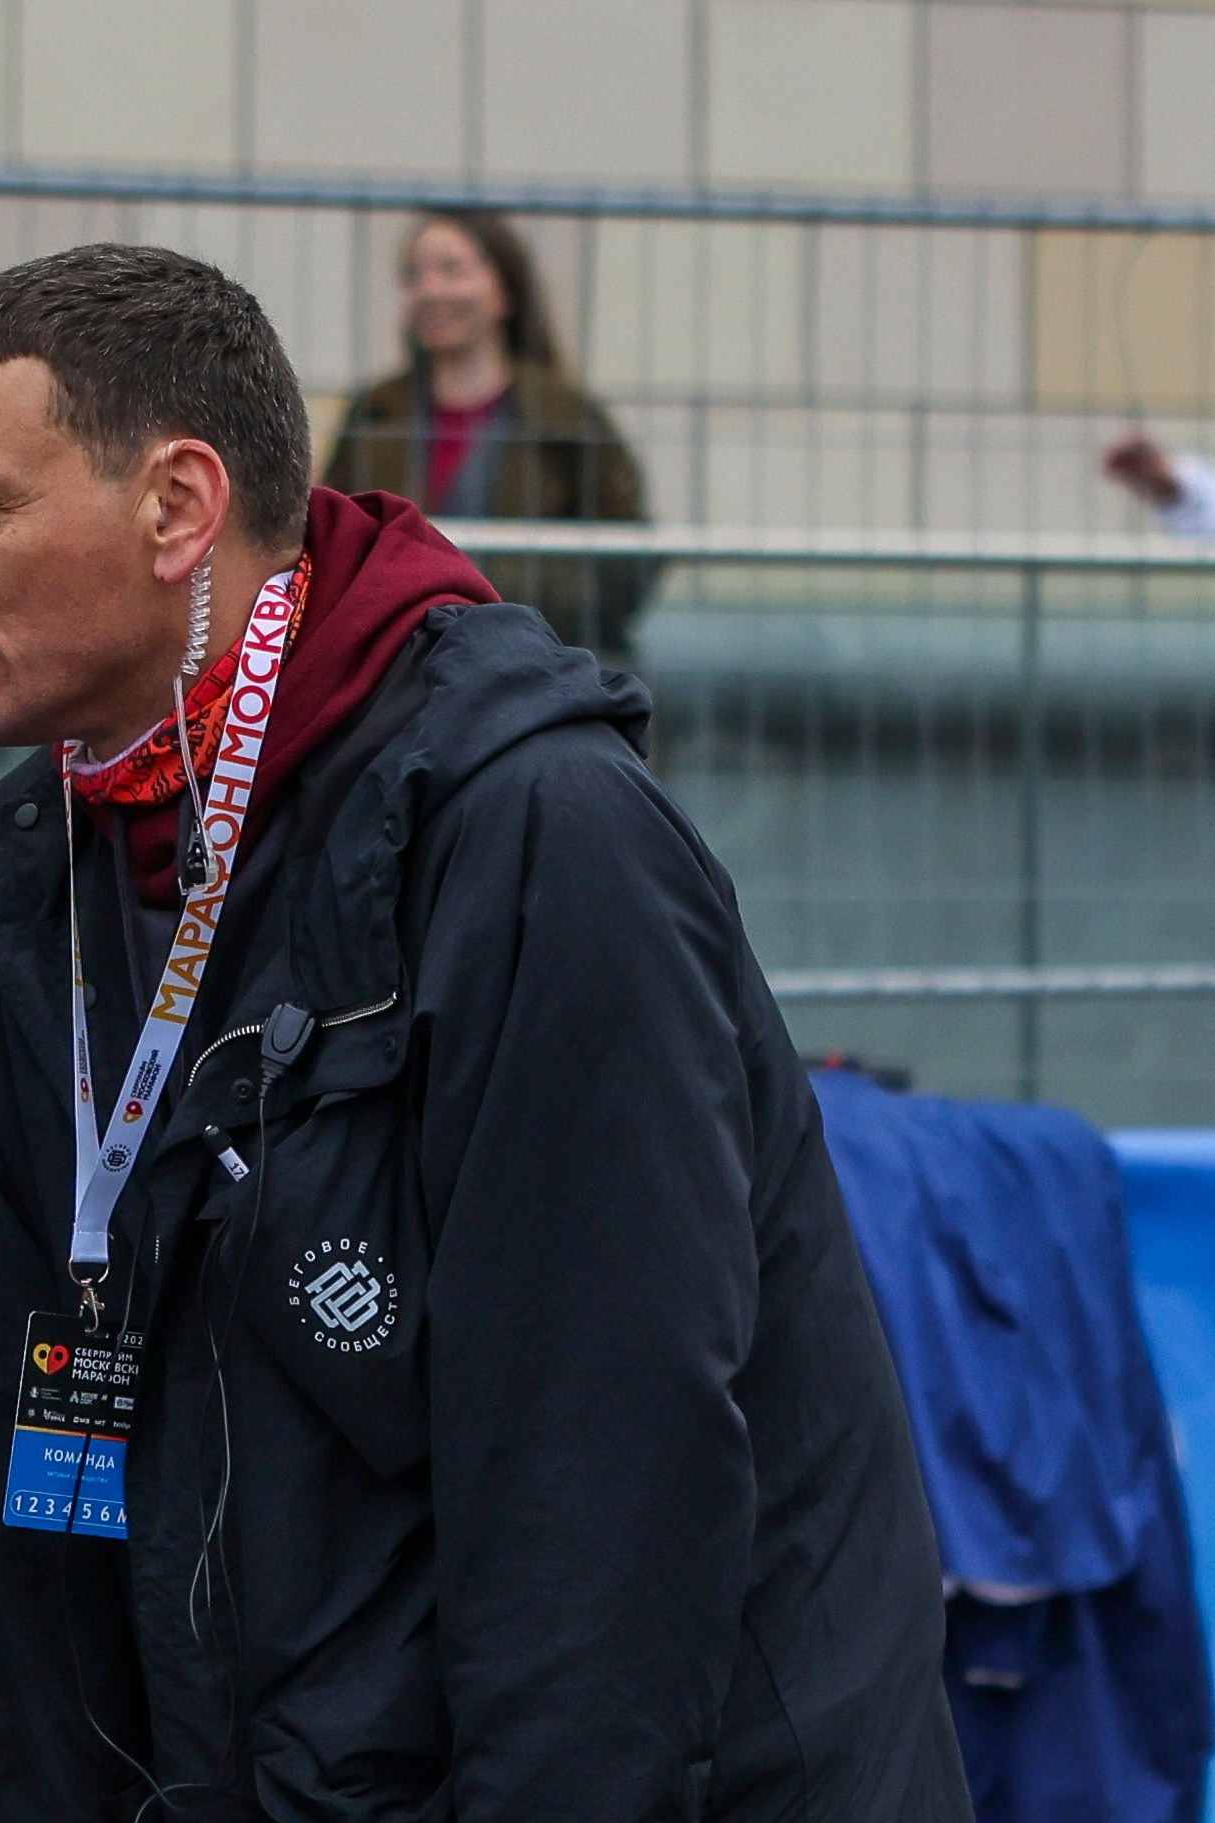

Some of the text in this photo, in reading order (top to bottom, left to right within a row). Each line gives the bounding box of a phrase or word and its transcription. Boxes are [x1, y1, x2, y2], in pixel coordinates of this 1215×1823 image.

[289, 1238, 369, 1306] БЕГОВОЕ
[314, 1273, 398, 1352] СООБЩЕСТВО
[74, 1347, 133, 1361] СБЕРПРЙМ
[71, 1368, 131, 1386] МАРАОН
